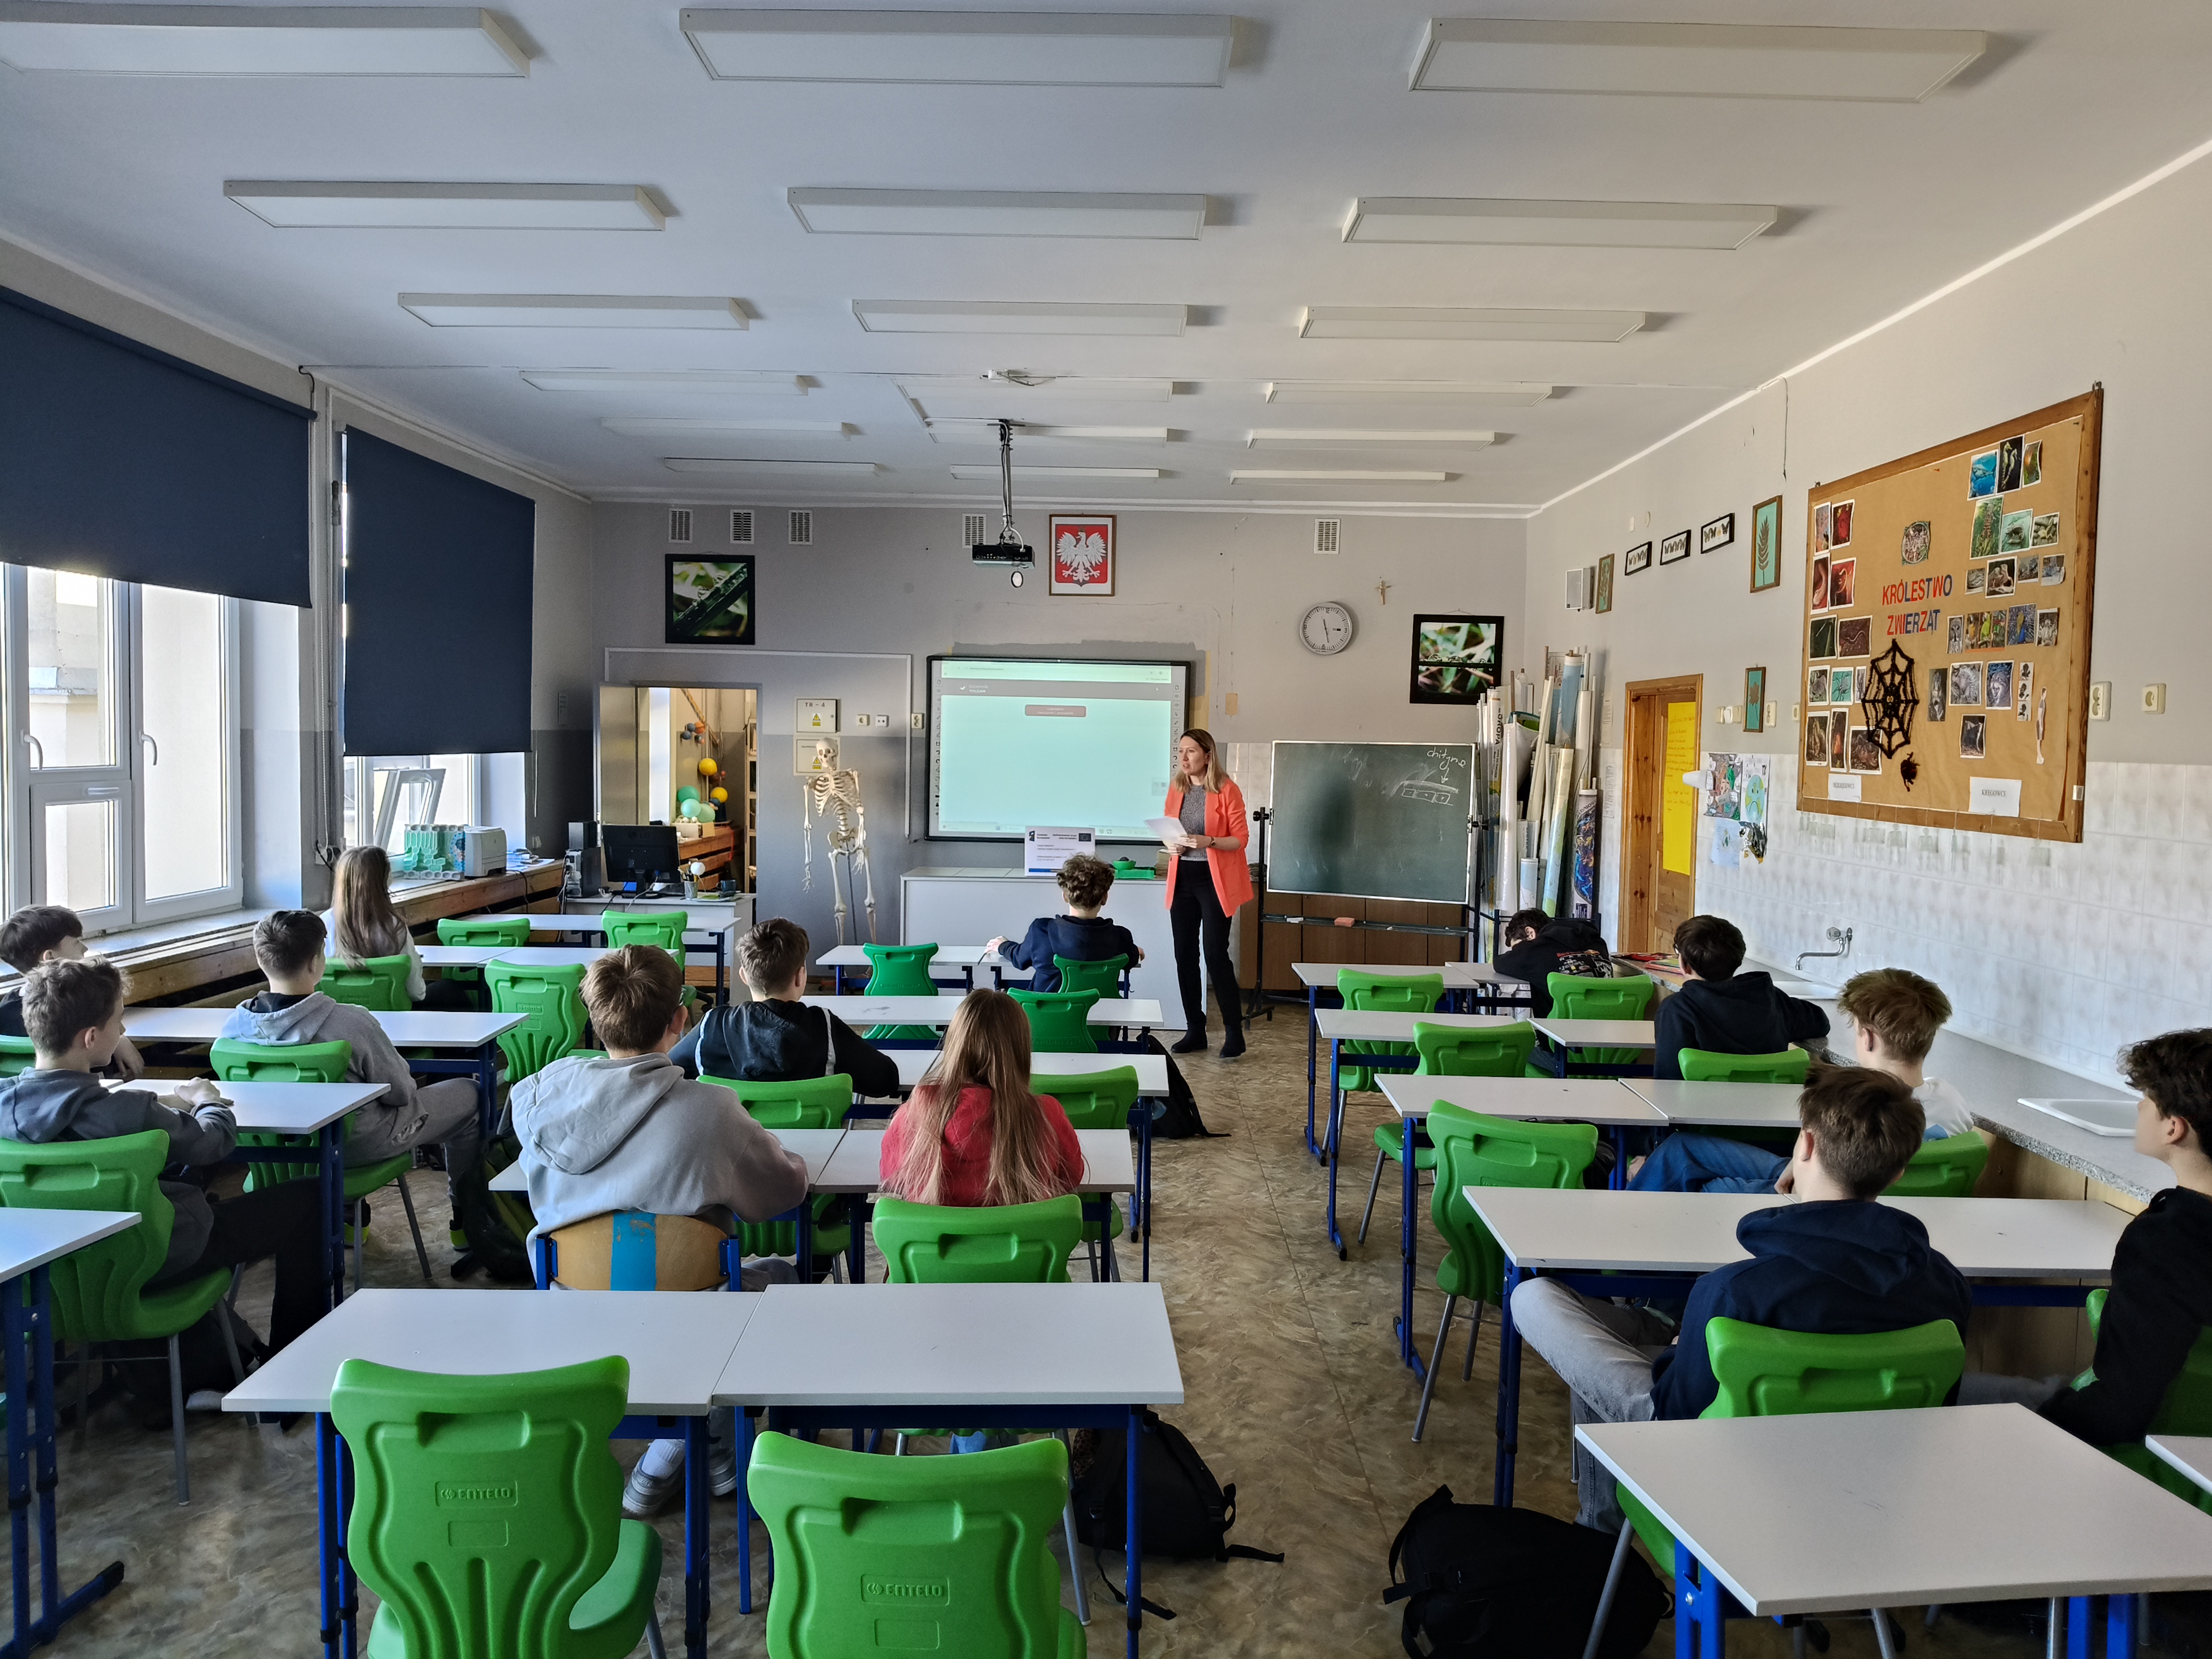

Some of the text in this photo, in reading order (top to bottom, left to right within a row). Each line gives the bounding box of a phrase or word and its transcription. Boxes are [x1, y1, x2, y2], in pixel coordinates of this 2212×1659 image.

[1882, 574, 1953, 605] KRÓLESTWO
[1887, 609, 1940, 635] ZWIERZĄT
[1981, 789, 2007, 797] KRĘGOWCE
[458, 1488, 512, 1500] ENTELO
[886, 1583, 942, 1597] ENTELO
